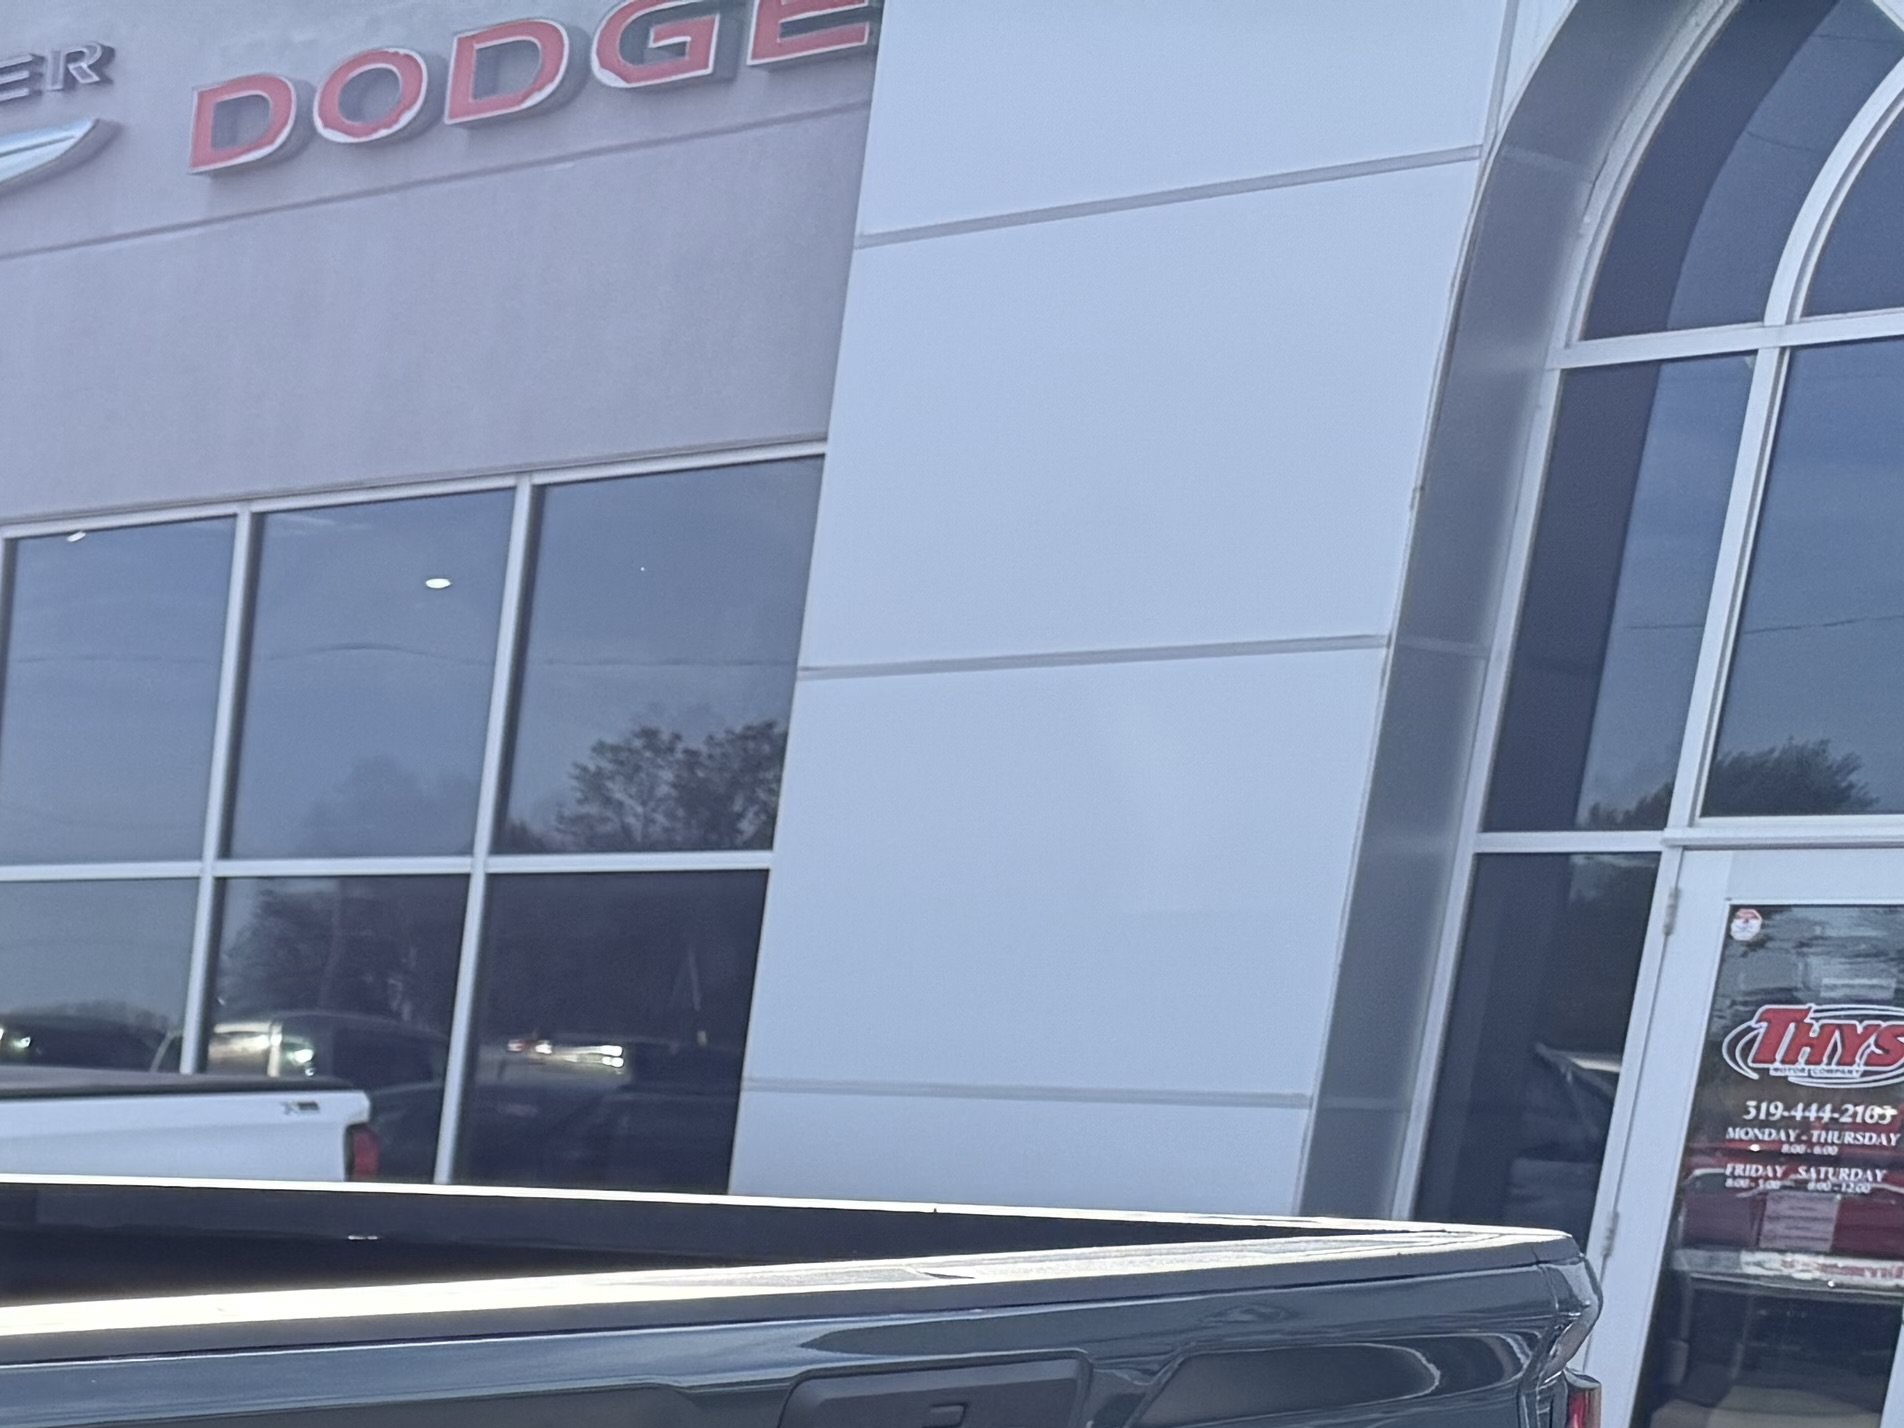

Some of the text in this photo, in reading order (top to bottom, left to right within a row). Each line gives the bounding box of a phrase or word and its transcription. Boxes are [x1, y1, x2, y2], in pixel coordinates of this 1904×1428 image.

[189, 0, 871, 175] DODGE
[1748, 1003, 1904, 1071] THYS
[1770, 1066, 1862, 1078] MOTOR COMPANY
[1725, 1126, 1800, 1142] MONDAY
[1810, 1129, 1901, 1147] THURSDAY
[1724, 1163, 1789, 1178] FRIDAY
[1797, 1165, 1888, 1183] SATURDAY
